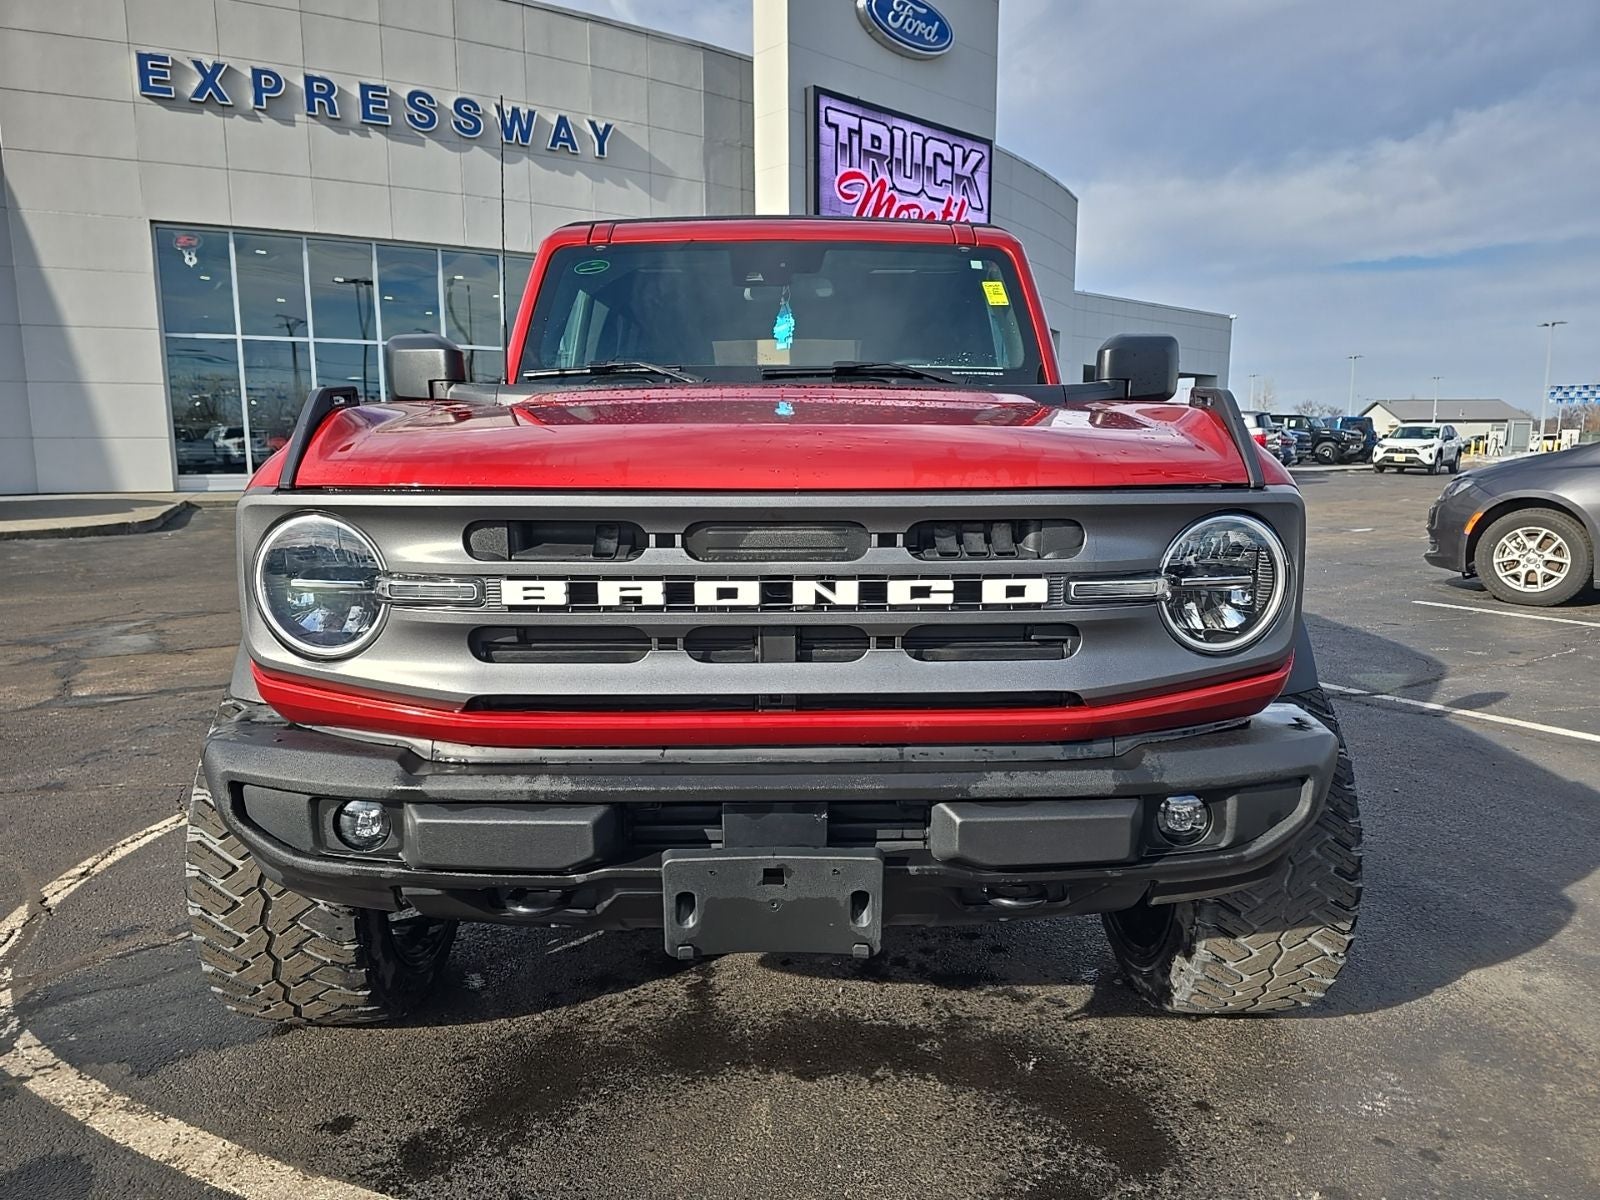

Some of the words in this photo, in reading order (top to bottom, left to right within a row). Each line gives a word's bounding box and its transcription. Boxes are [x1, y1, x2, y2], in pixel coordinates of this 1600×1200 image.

[888, 0, 939, 42] Ford
[136, 50, 615, 158] EXPRESSWAY
[825, 106, 985, 211] TRUCK
[501, 578, 1049, 606] BRONCO
